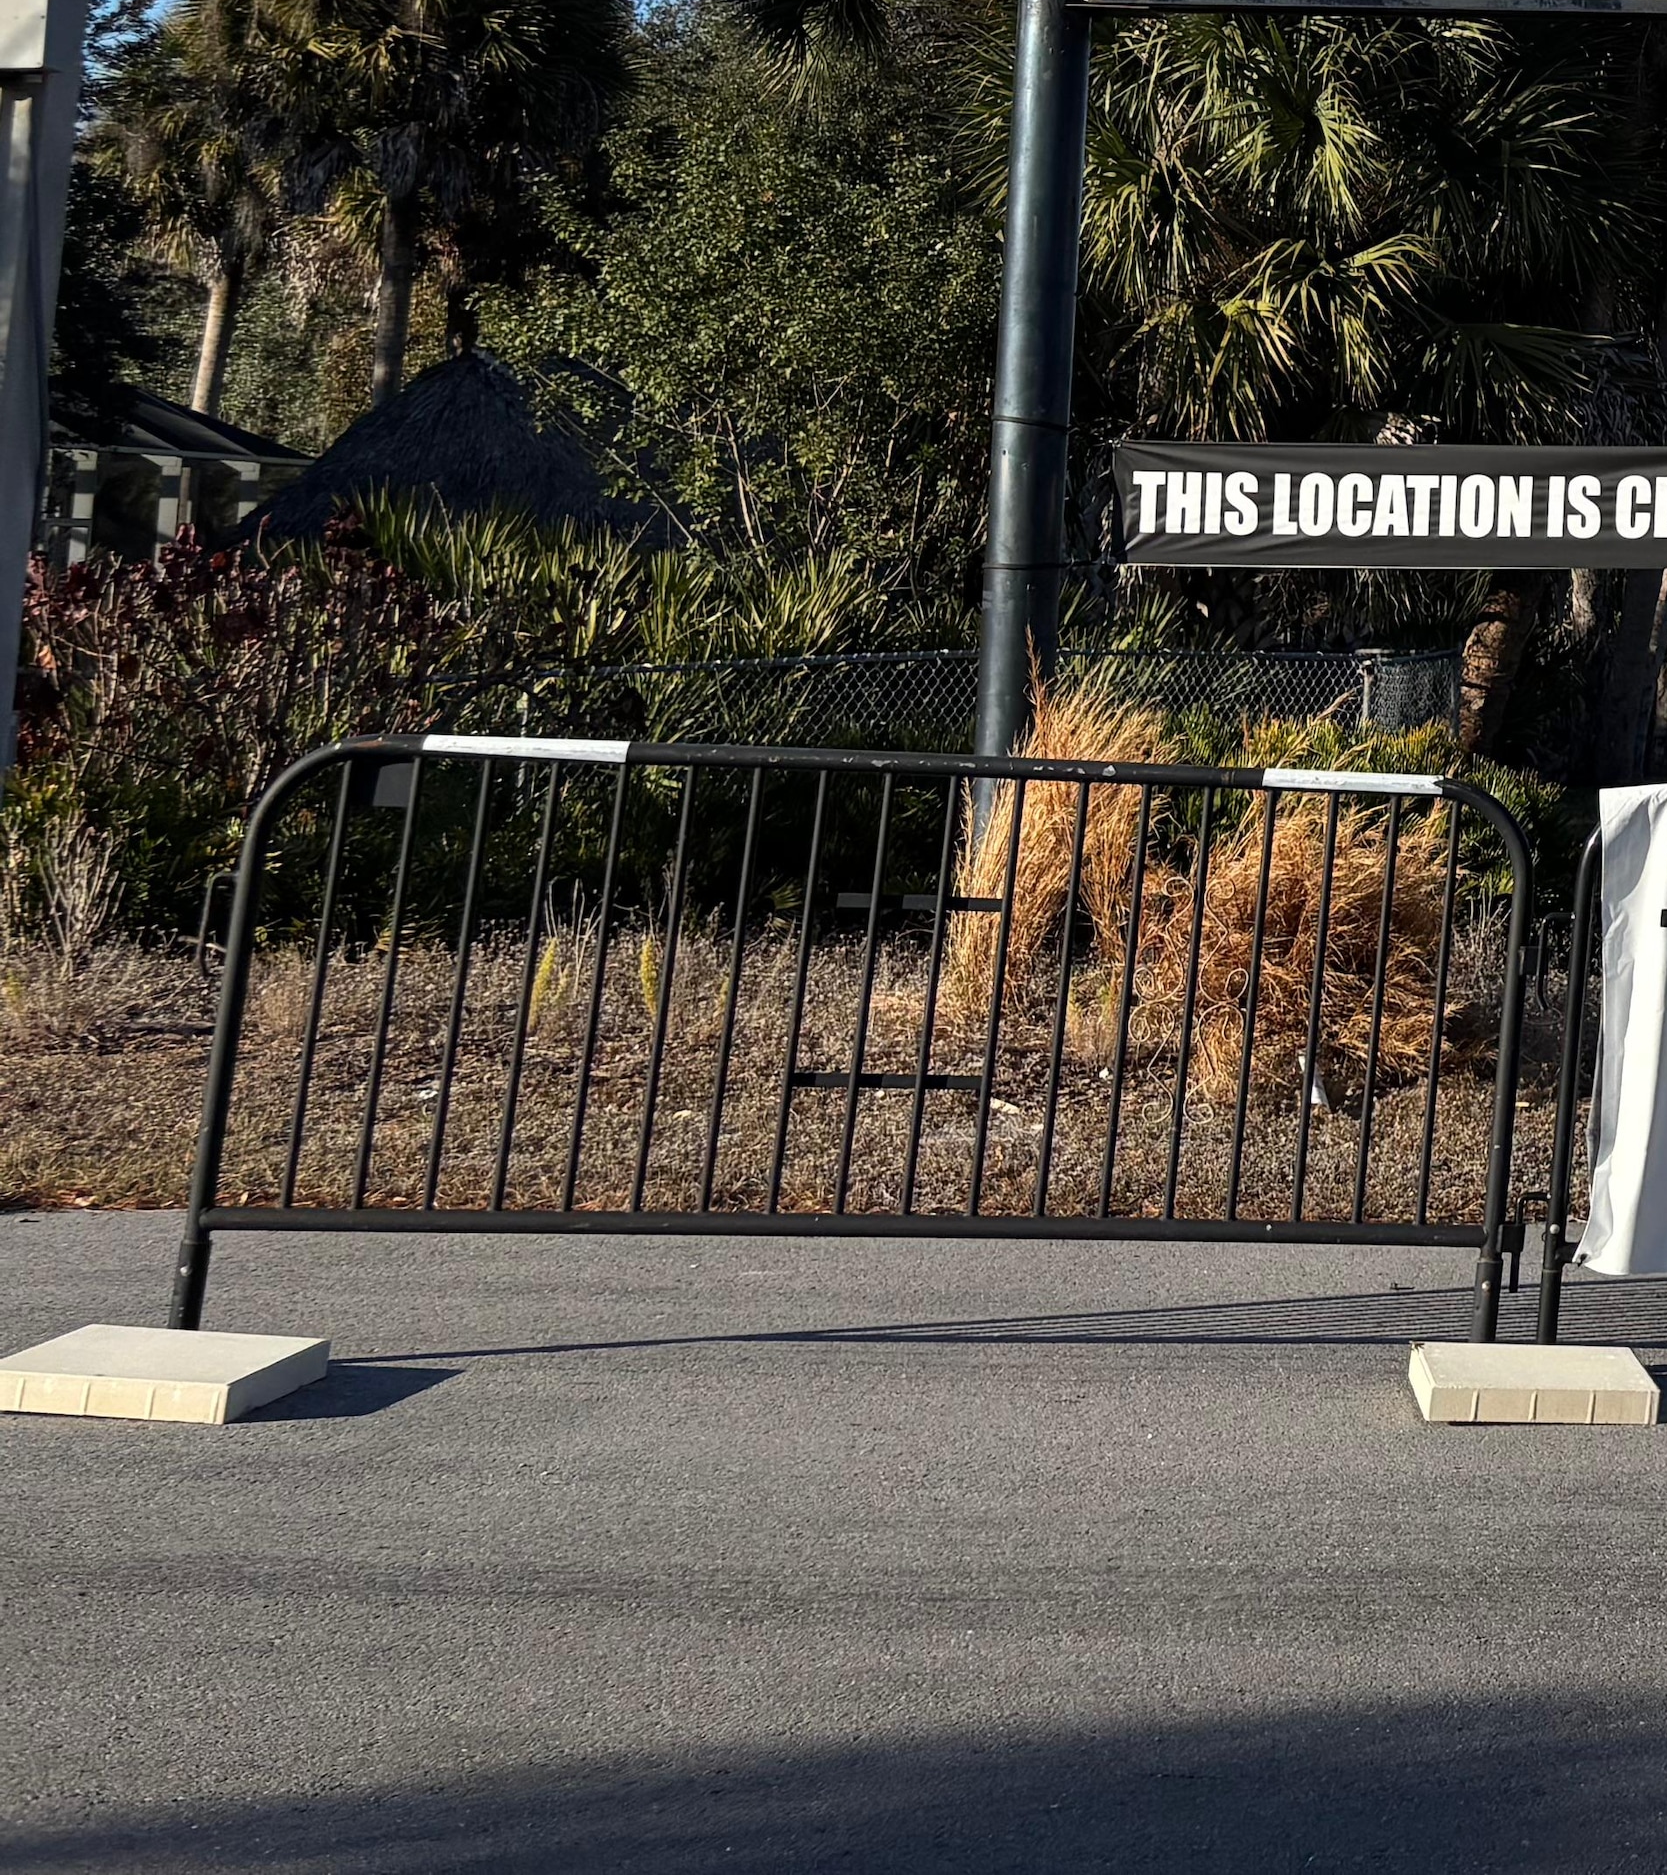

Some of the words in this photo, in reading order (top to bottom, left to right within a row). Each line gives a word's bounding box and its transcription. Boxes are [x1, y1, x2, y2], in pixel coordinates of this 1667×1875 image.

[1133, 471, 1258, 535] THIS
[1273, 473, 1533, 537] LOCATION
[1547, 475, 1600, 538] IS
